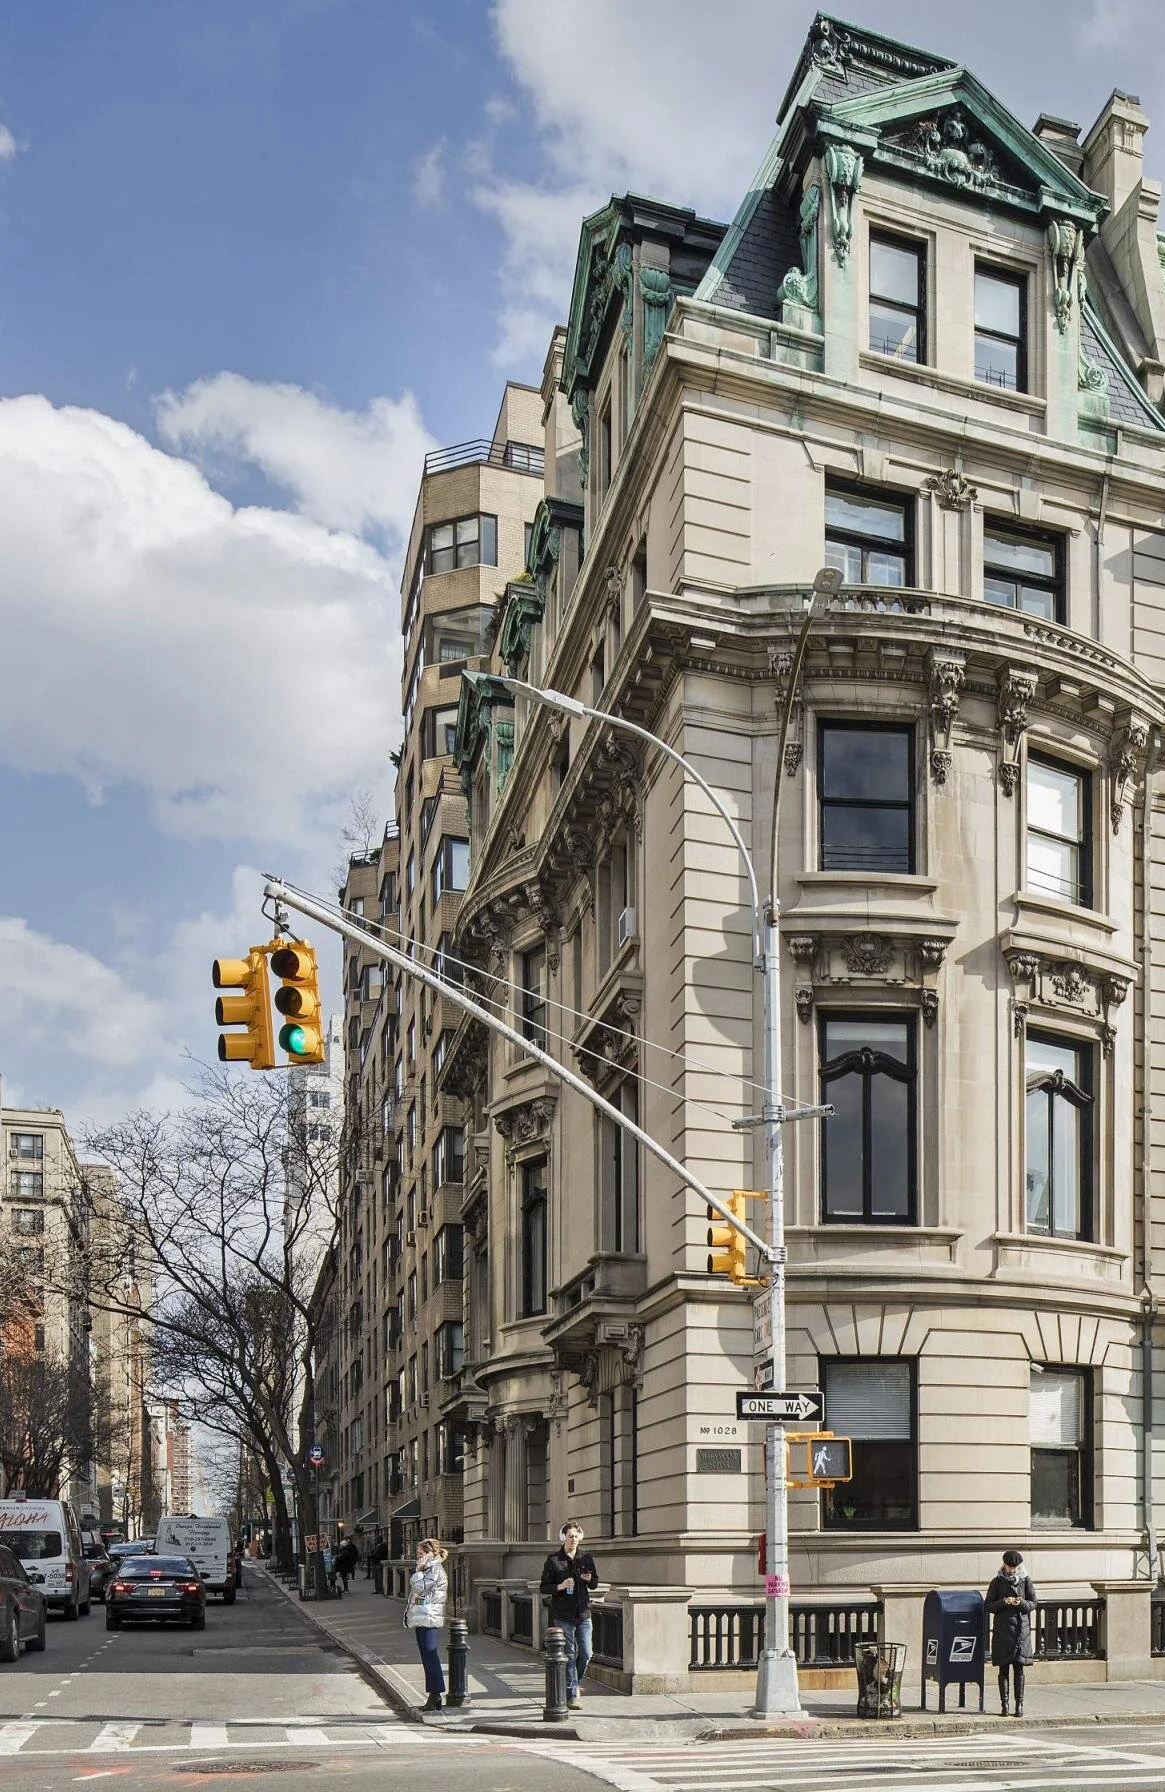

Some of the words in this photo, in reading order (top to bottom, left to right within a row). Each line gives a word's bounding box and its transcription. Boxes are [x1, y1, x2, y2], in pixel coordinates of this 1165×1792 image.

[748, 1401, 774, 1413] ONE
[784, 1401, 811, 1413] WAY
[713, 1426, 737, 1434] 1028
[0, 1511, 49, 1529] ALOHA
